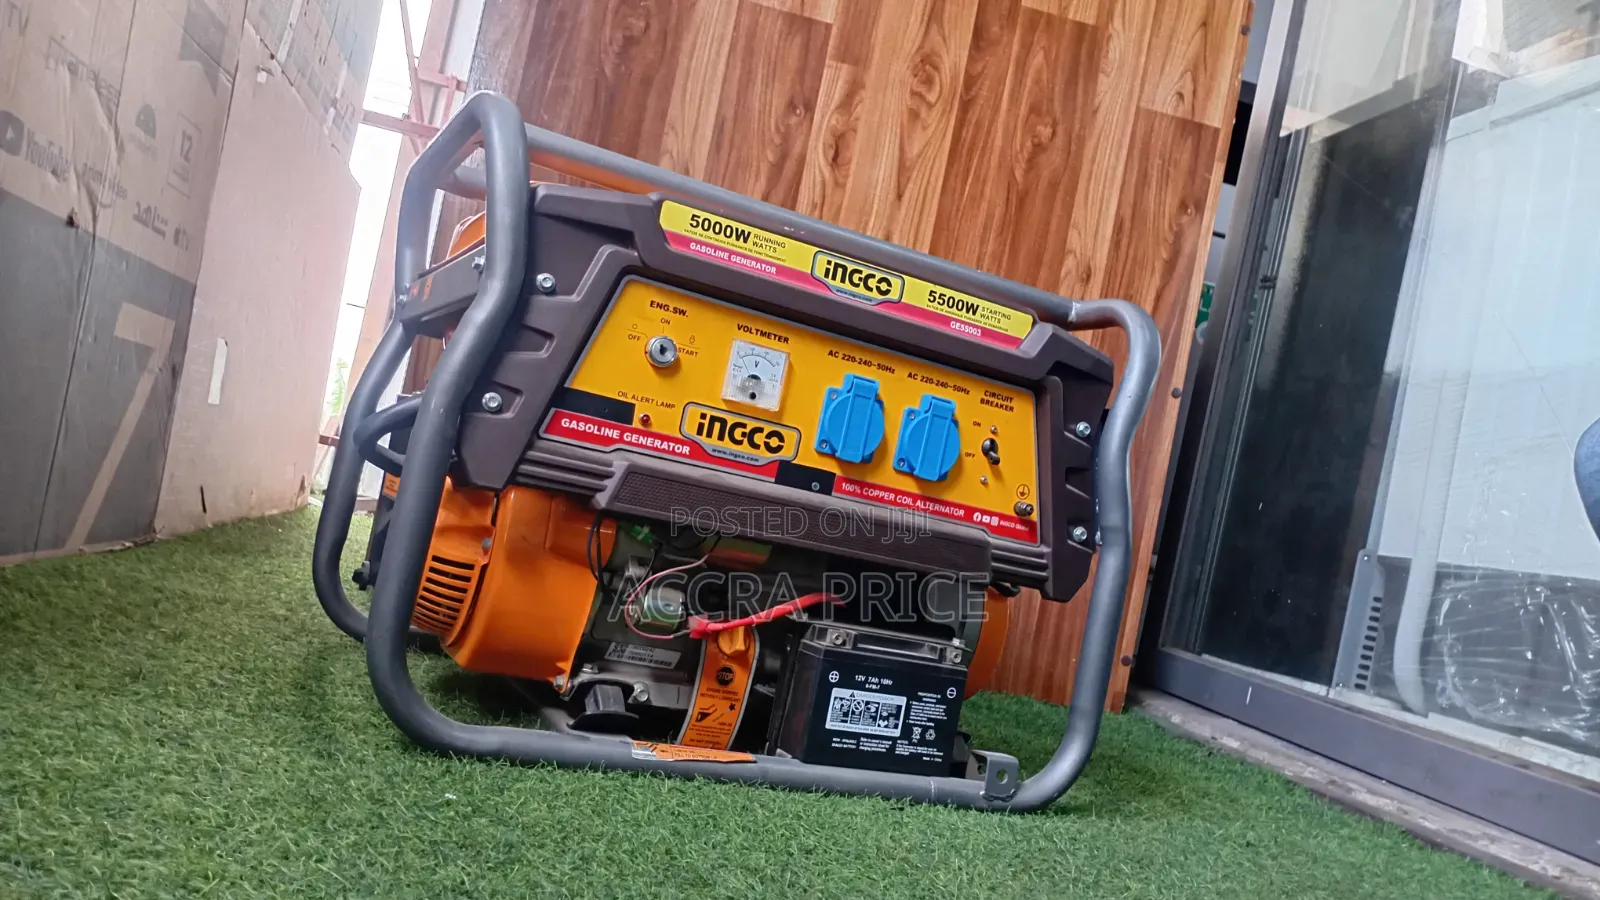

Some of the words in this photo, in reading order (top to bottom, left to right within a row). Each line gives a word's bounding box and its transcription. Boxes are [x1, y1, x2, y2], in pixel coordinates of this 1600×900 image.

[689, 214, 752, 244] 5000W
[752, 240, 778, 254] WATTS
[754, 233, 786, 249] RUNNING
[690, 242, 729, 260] GASOLINE
[731, 254, 777, 274] GENERATOR
[650, 300, 688, 318] ENG.SW.
[928, 290, 980, 316] 5500W
[980, 313, 1001, 324] WATTS
[982, 306, 1011, 320] STARTING
[628, 333, 641, 342] OFF
[737, 323, 790, 344] VOLTMETER
[678, 347, 698, 357] START
[828, 350, 840, 359] AC
[907, 372, 918, 380] AC
[618, 390, 629, 400] OIL
[631, 393, 654, 406] ALERT
[656, 400, 676, 410] LAMP
[984, 390, 1014, 403] CIRCUIT
[980, 398, 1014, 413] BREAKER
[561, 417, 621, 440] GASOLINE
[623, 432, 690, 456] GENERATOR
[841, 482, 861, 494] 100%
[862, 487, 895, 501] COPPER
[896, 494, 914, 505] COIL
[915, 499, 965, 518] ALTERNATOR
[718, 671, 734, 680] STOP
